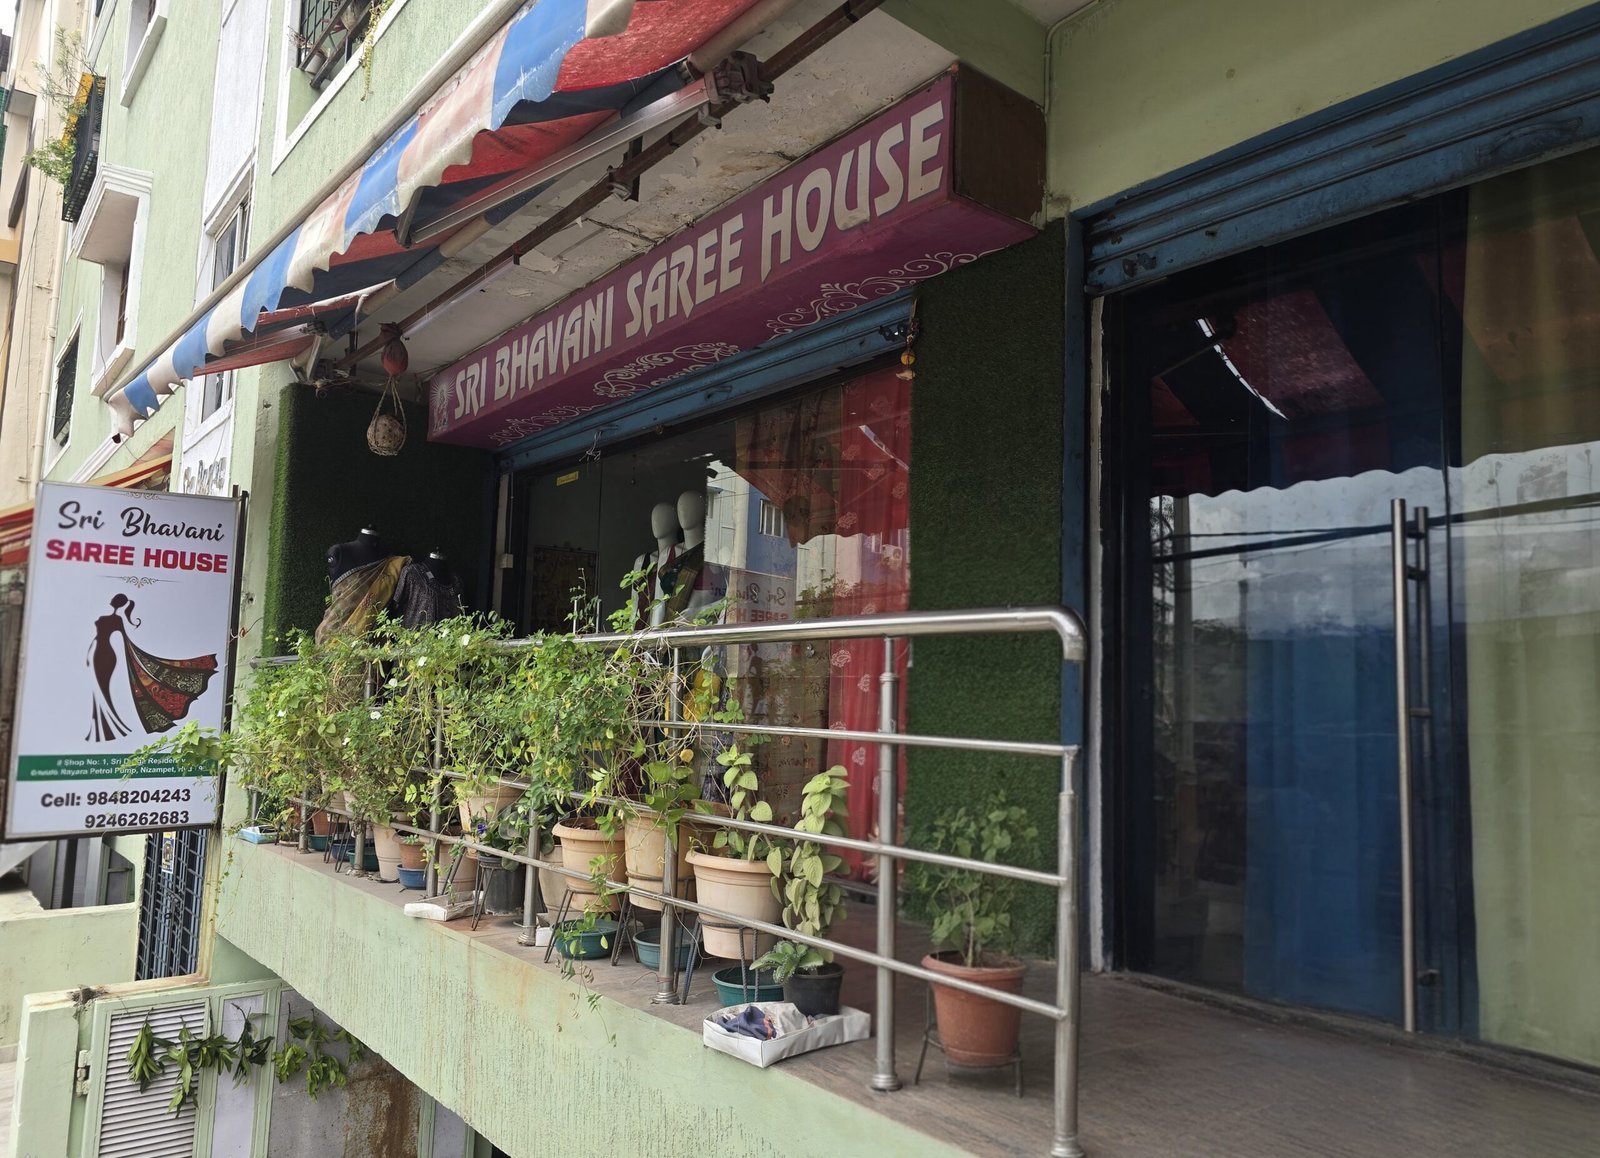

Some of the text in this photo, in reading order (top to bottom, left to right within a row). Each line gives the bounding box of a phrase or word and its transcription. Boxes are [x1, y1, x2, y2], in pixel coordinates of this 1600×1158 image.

[454, 100, 944, 420] SRI BHAVANI SAREE HOUSE
[57, 500, 225, 542] Sri Bhavani
[46, 539, 228, 574] SAREE HOUSE
[64, 758, 85, 766] Shop
[111, 757, 121, 765] Sri
[61, 768, 88, 777] Nayara
[90, 767, 113, 775] Petrol
[41, 788, 191, 808] Cell: 9848204243
[84, 811, 190, 828] 9246262683
